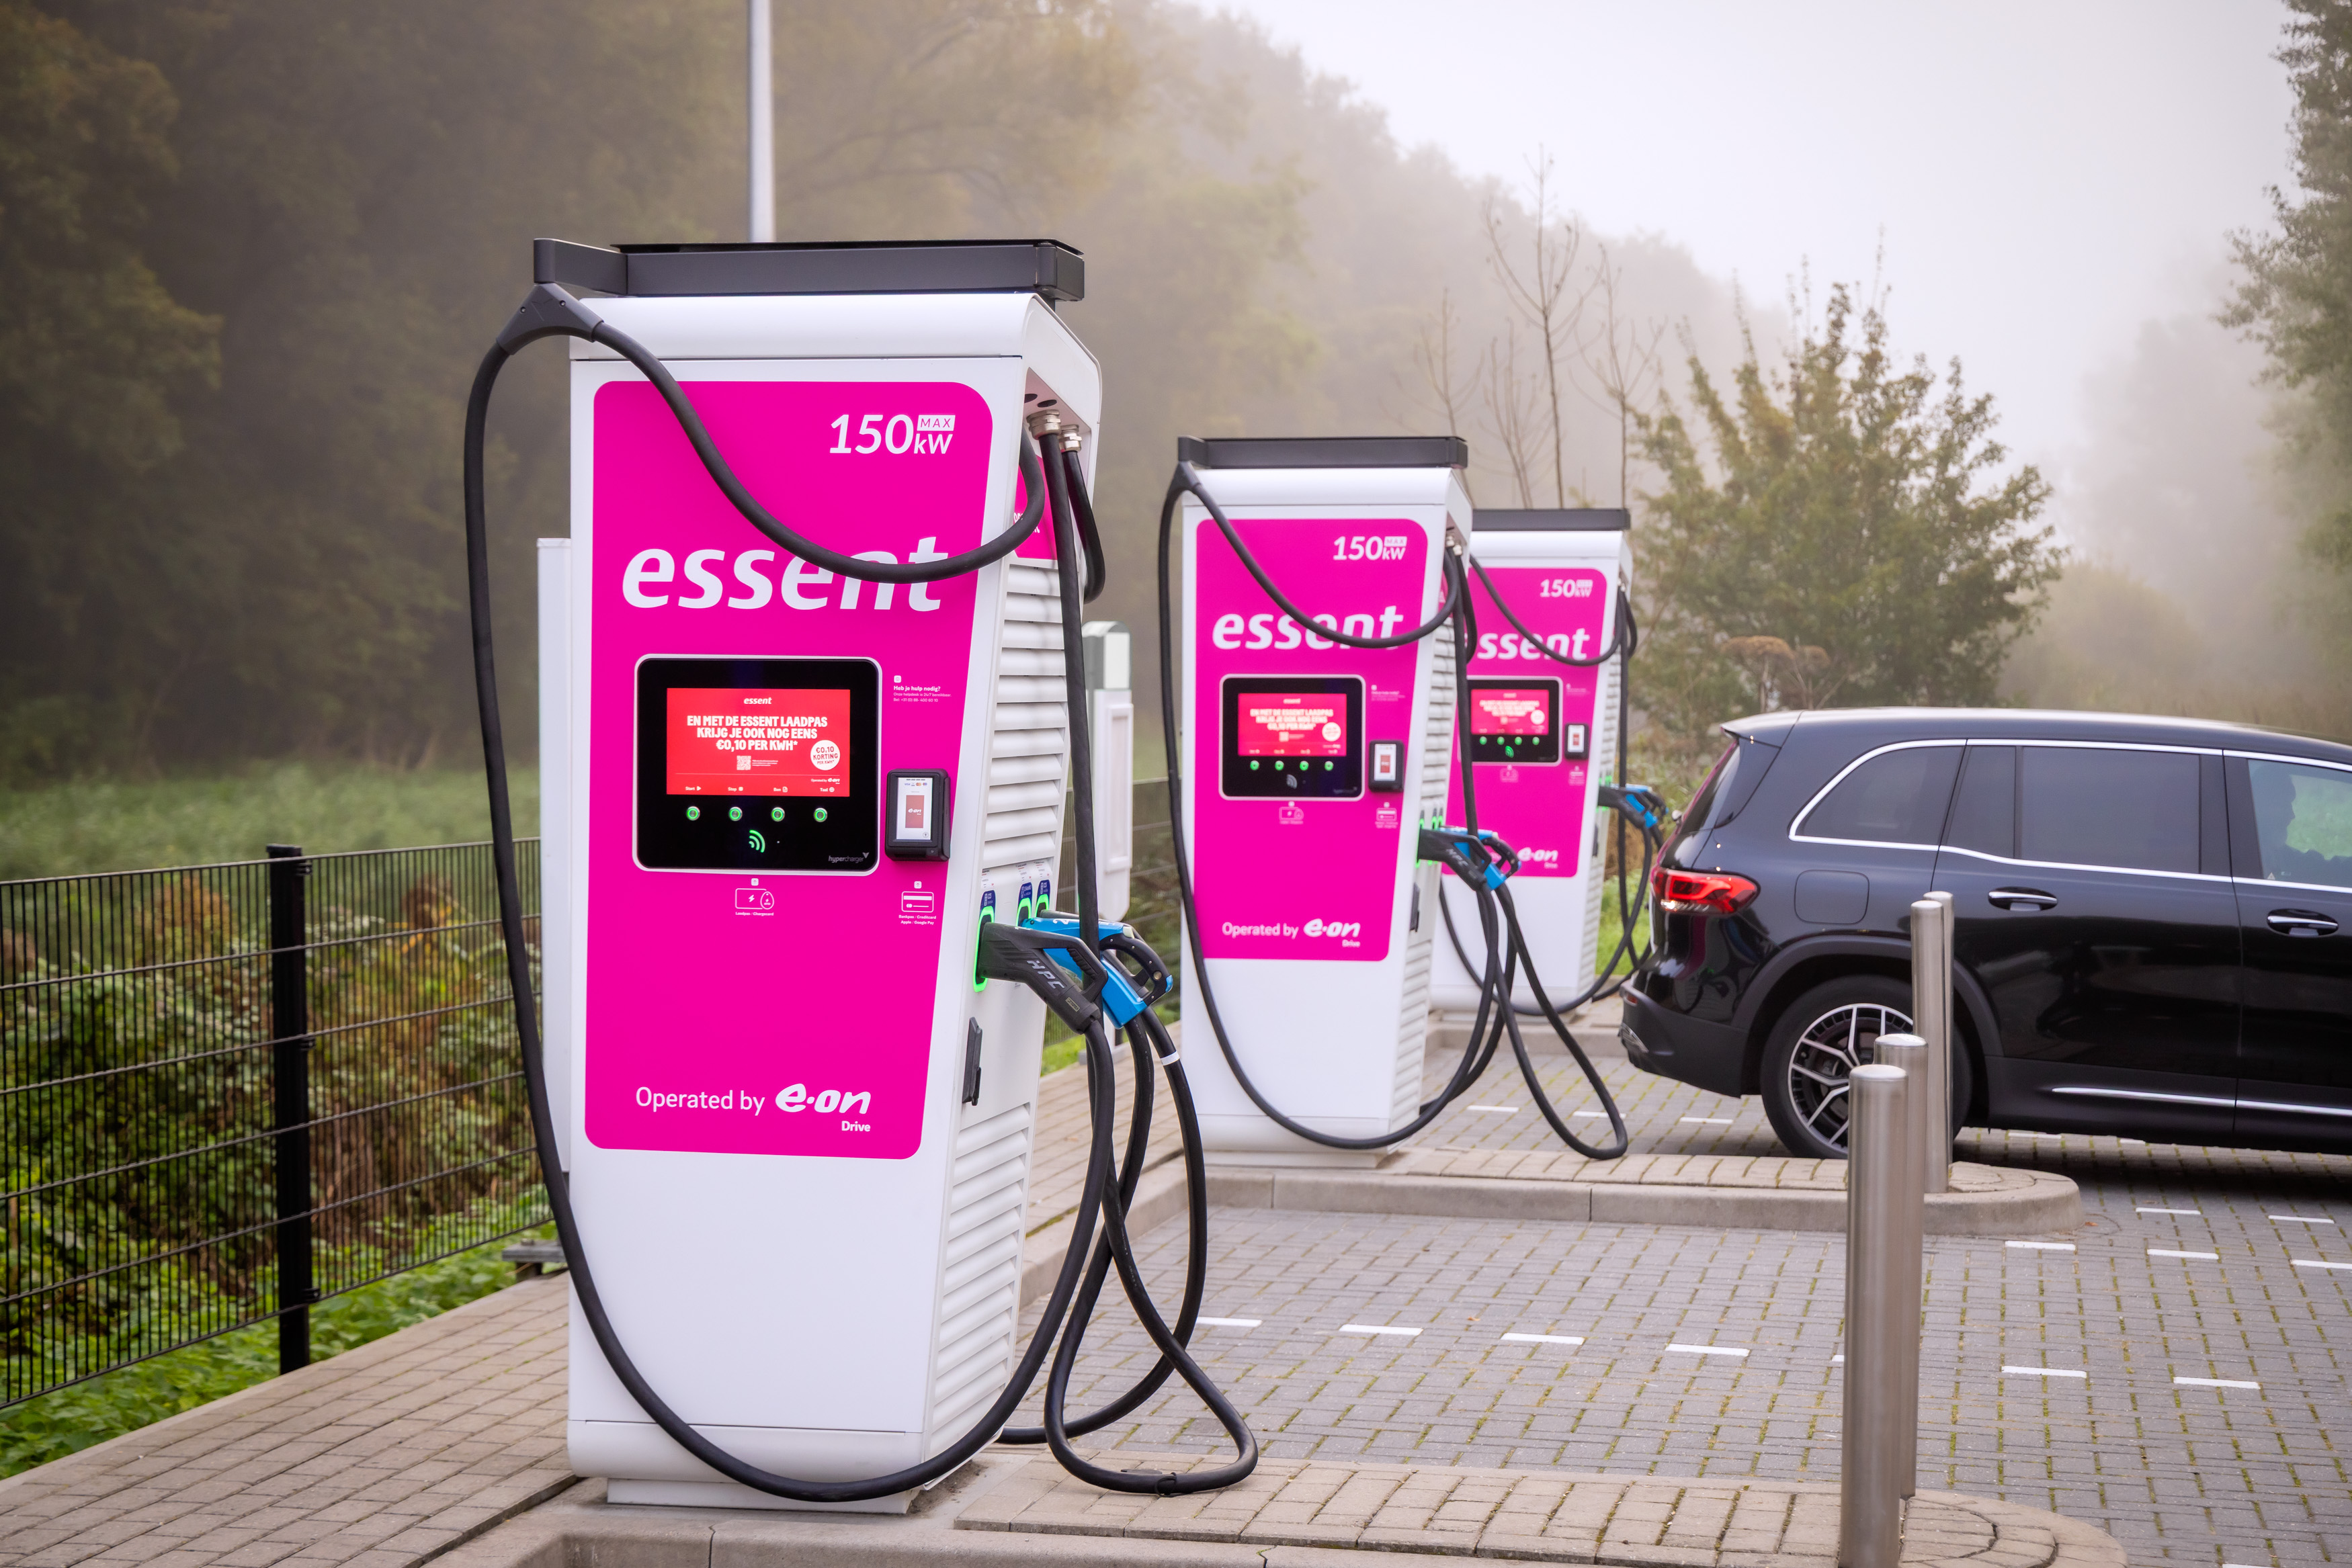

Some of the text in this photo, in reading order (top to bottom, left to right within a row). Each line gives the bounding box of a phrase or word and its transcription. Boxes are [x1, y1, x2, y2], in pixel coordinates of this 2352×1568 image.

[921, 418, 951, 428] MAX
[830, 415, 953, 454] 150 kW
[1333, 536, 1406, 560] 150 kW
[622, 537, 948, 612] essent
[1540, 579, 1575, 597] 150
[1464, 627, 1590, 660] ssent
[687, 715, 827, 727] EN MET DE ESSENT LAADPAS
[697, 728, 817, 738] KRIJG JE OOK NOG EENS
[716, 740, 746, 752] €0,10
[748, 740, 768, 750] PER
[1222, 922, 1280, 938] Operated
[1283, 923, 1298, 939] by
[1027, 961, 1065, 989] HPC
[636, 1087, 732, 1112] Operated
[741, 1090, 765, 1116] by
[842, 1121, 870, 1131] Drive
